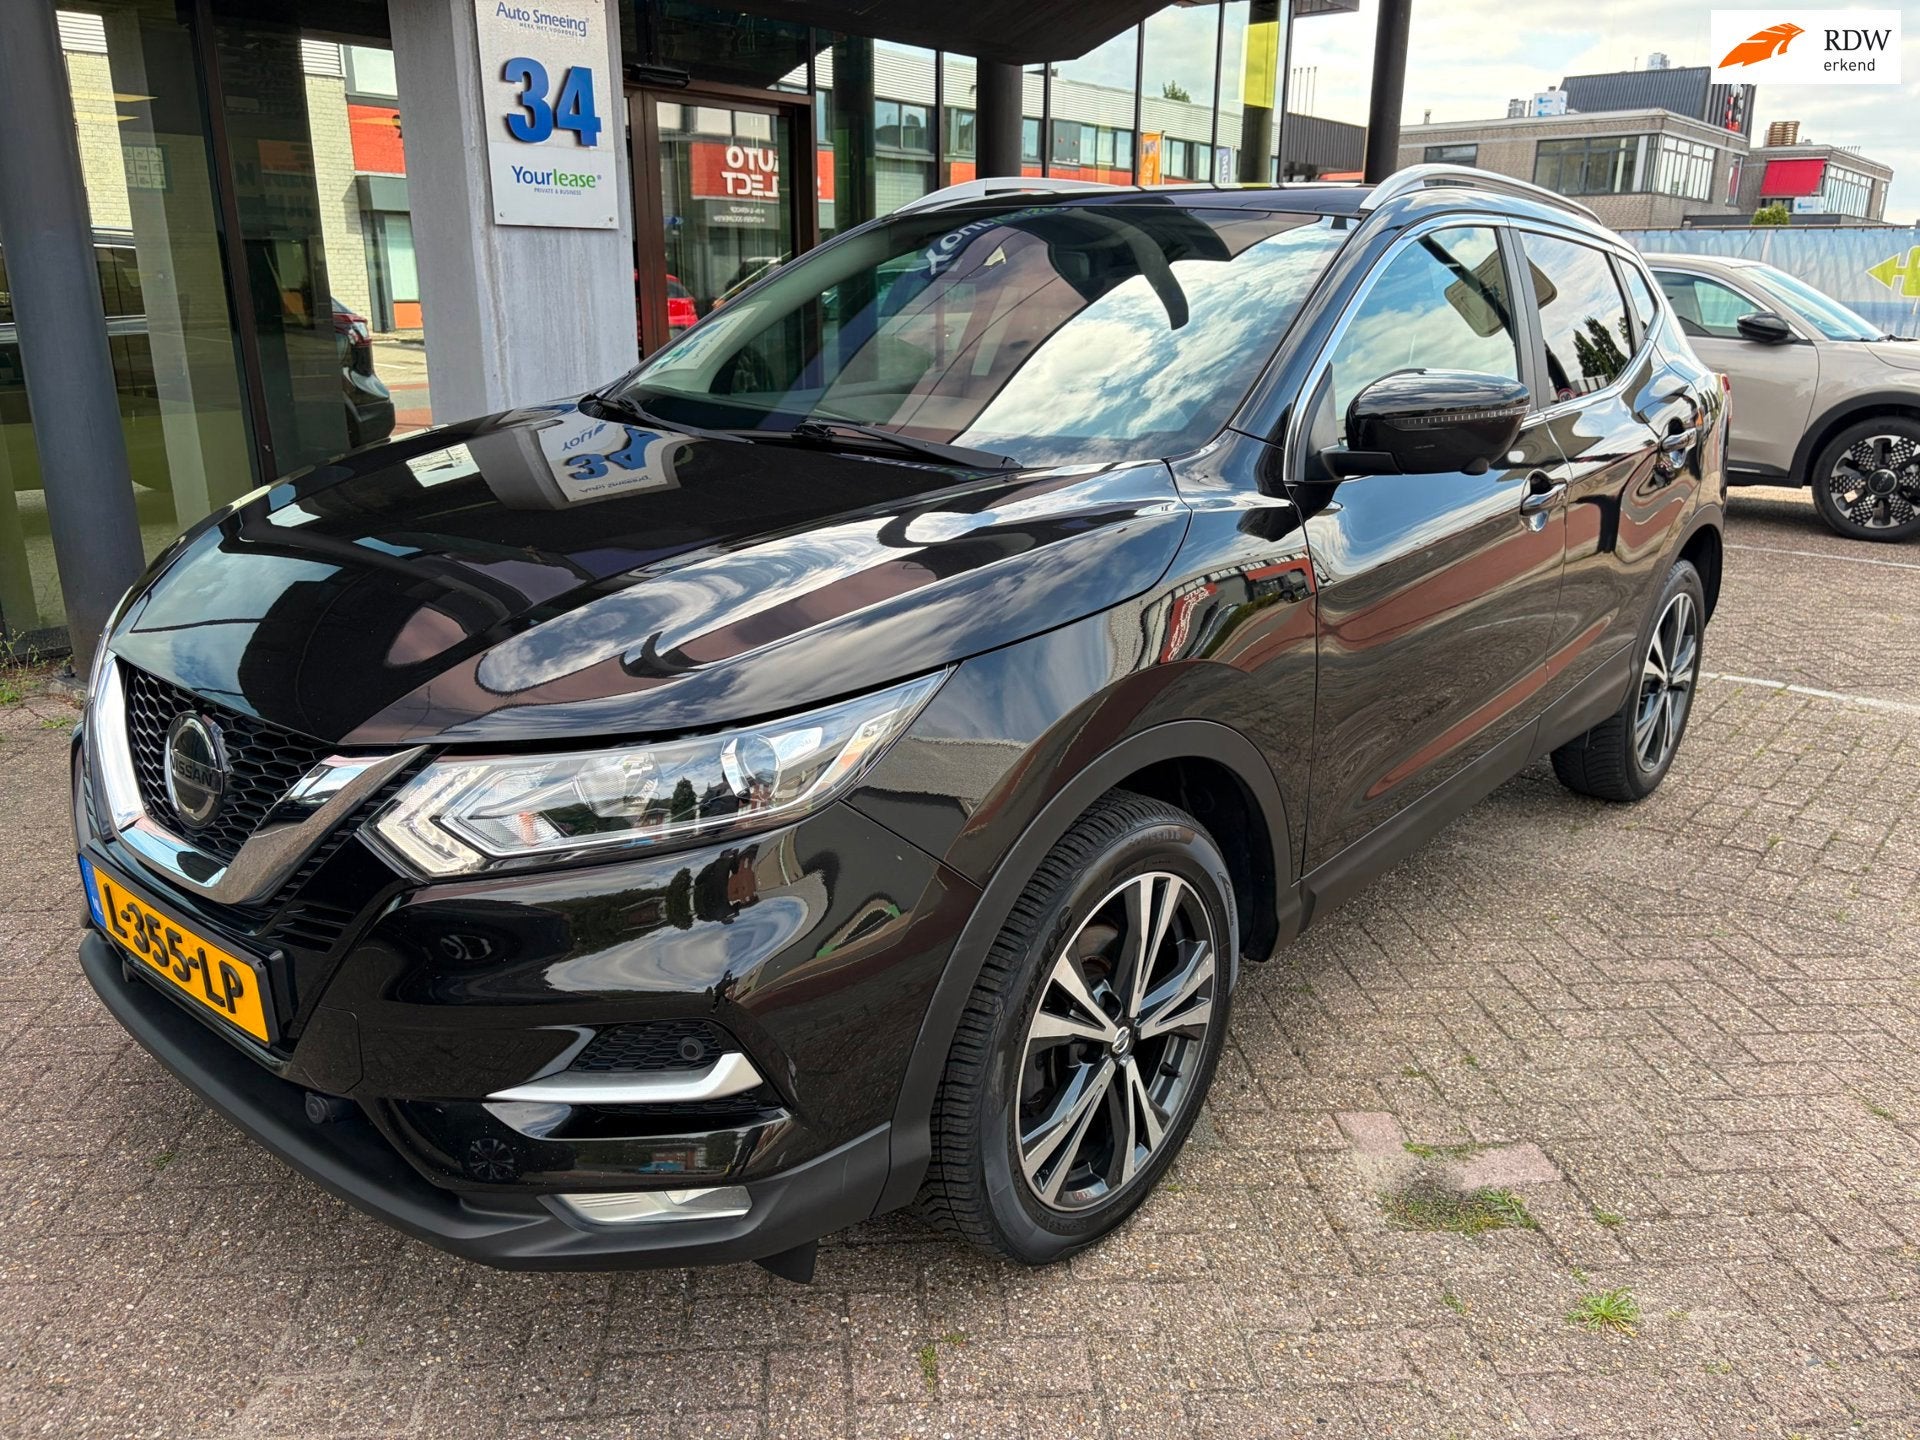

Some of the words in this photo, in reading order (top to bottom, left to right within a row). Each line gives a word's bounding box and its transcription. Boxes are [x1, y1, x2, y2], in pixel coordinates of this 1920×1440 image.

[495, 1, 531, 22] Auto
[533, 9, 587, 37] Smeeing
[505, 56, 602, 147] 34
[103, 883, 244, 1014] L-355-LP
